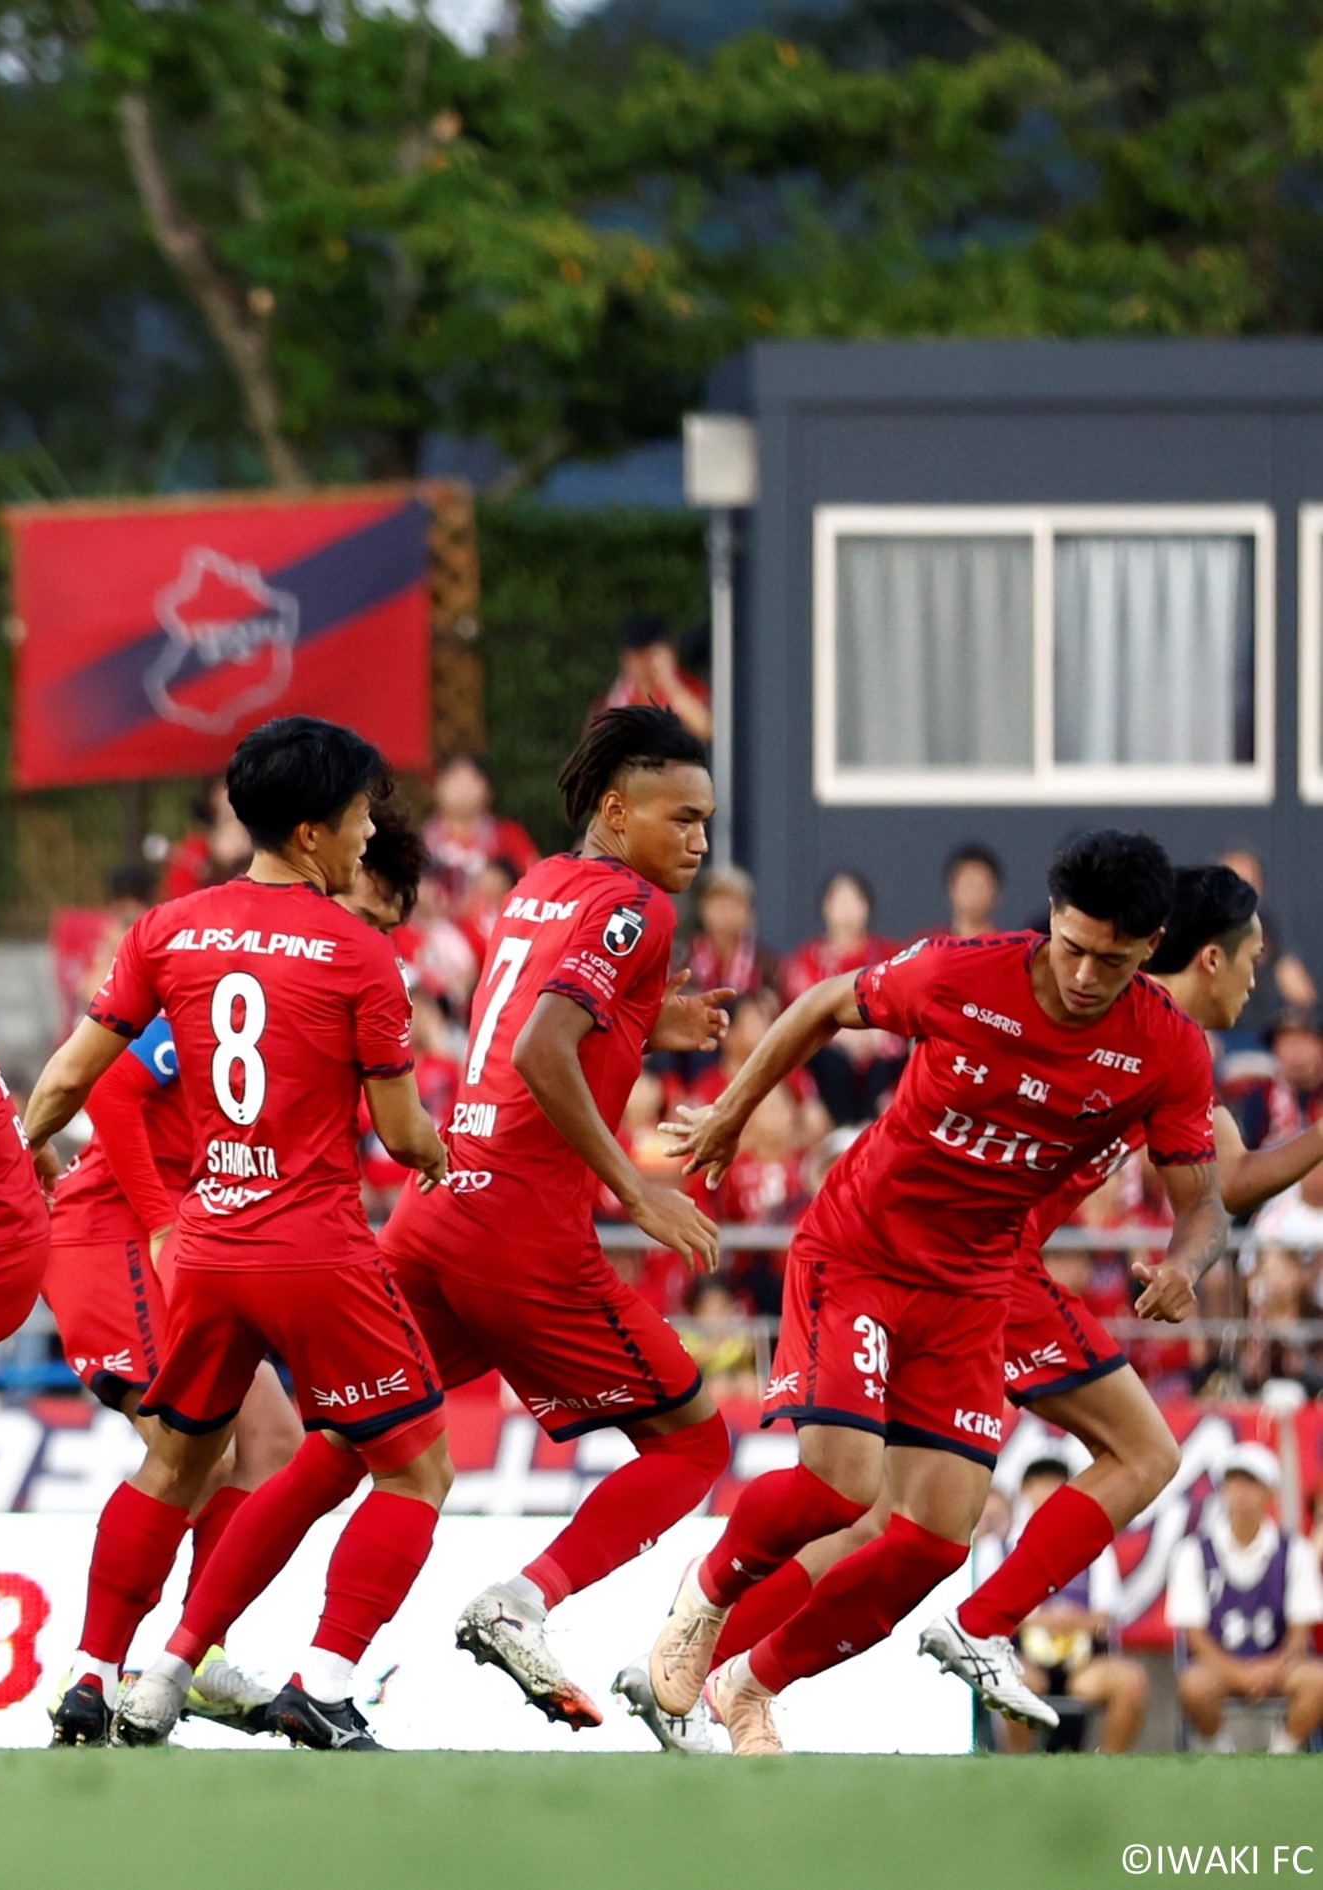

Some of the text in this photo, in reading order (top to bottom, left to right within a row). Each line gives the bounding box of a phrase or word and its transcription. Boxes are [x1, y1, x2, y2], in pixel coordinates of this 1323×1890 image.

[166, 928, 337, 962] ALPSALPINE
[466, 936, 533, 1086] 7
[210, 971, 267, 1127] 8
[1087, 1047, 1143, 1074] ASTEC
[929, 1106, 1073, 1172] BHC
[315, 1376, 407, 1408] ABLE
